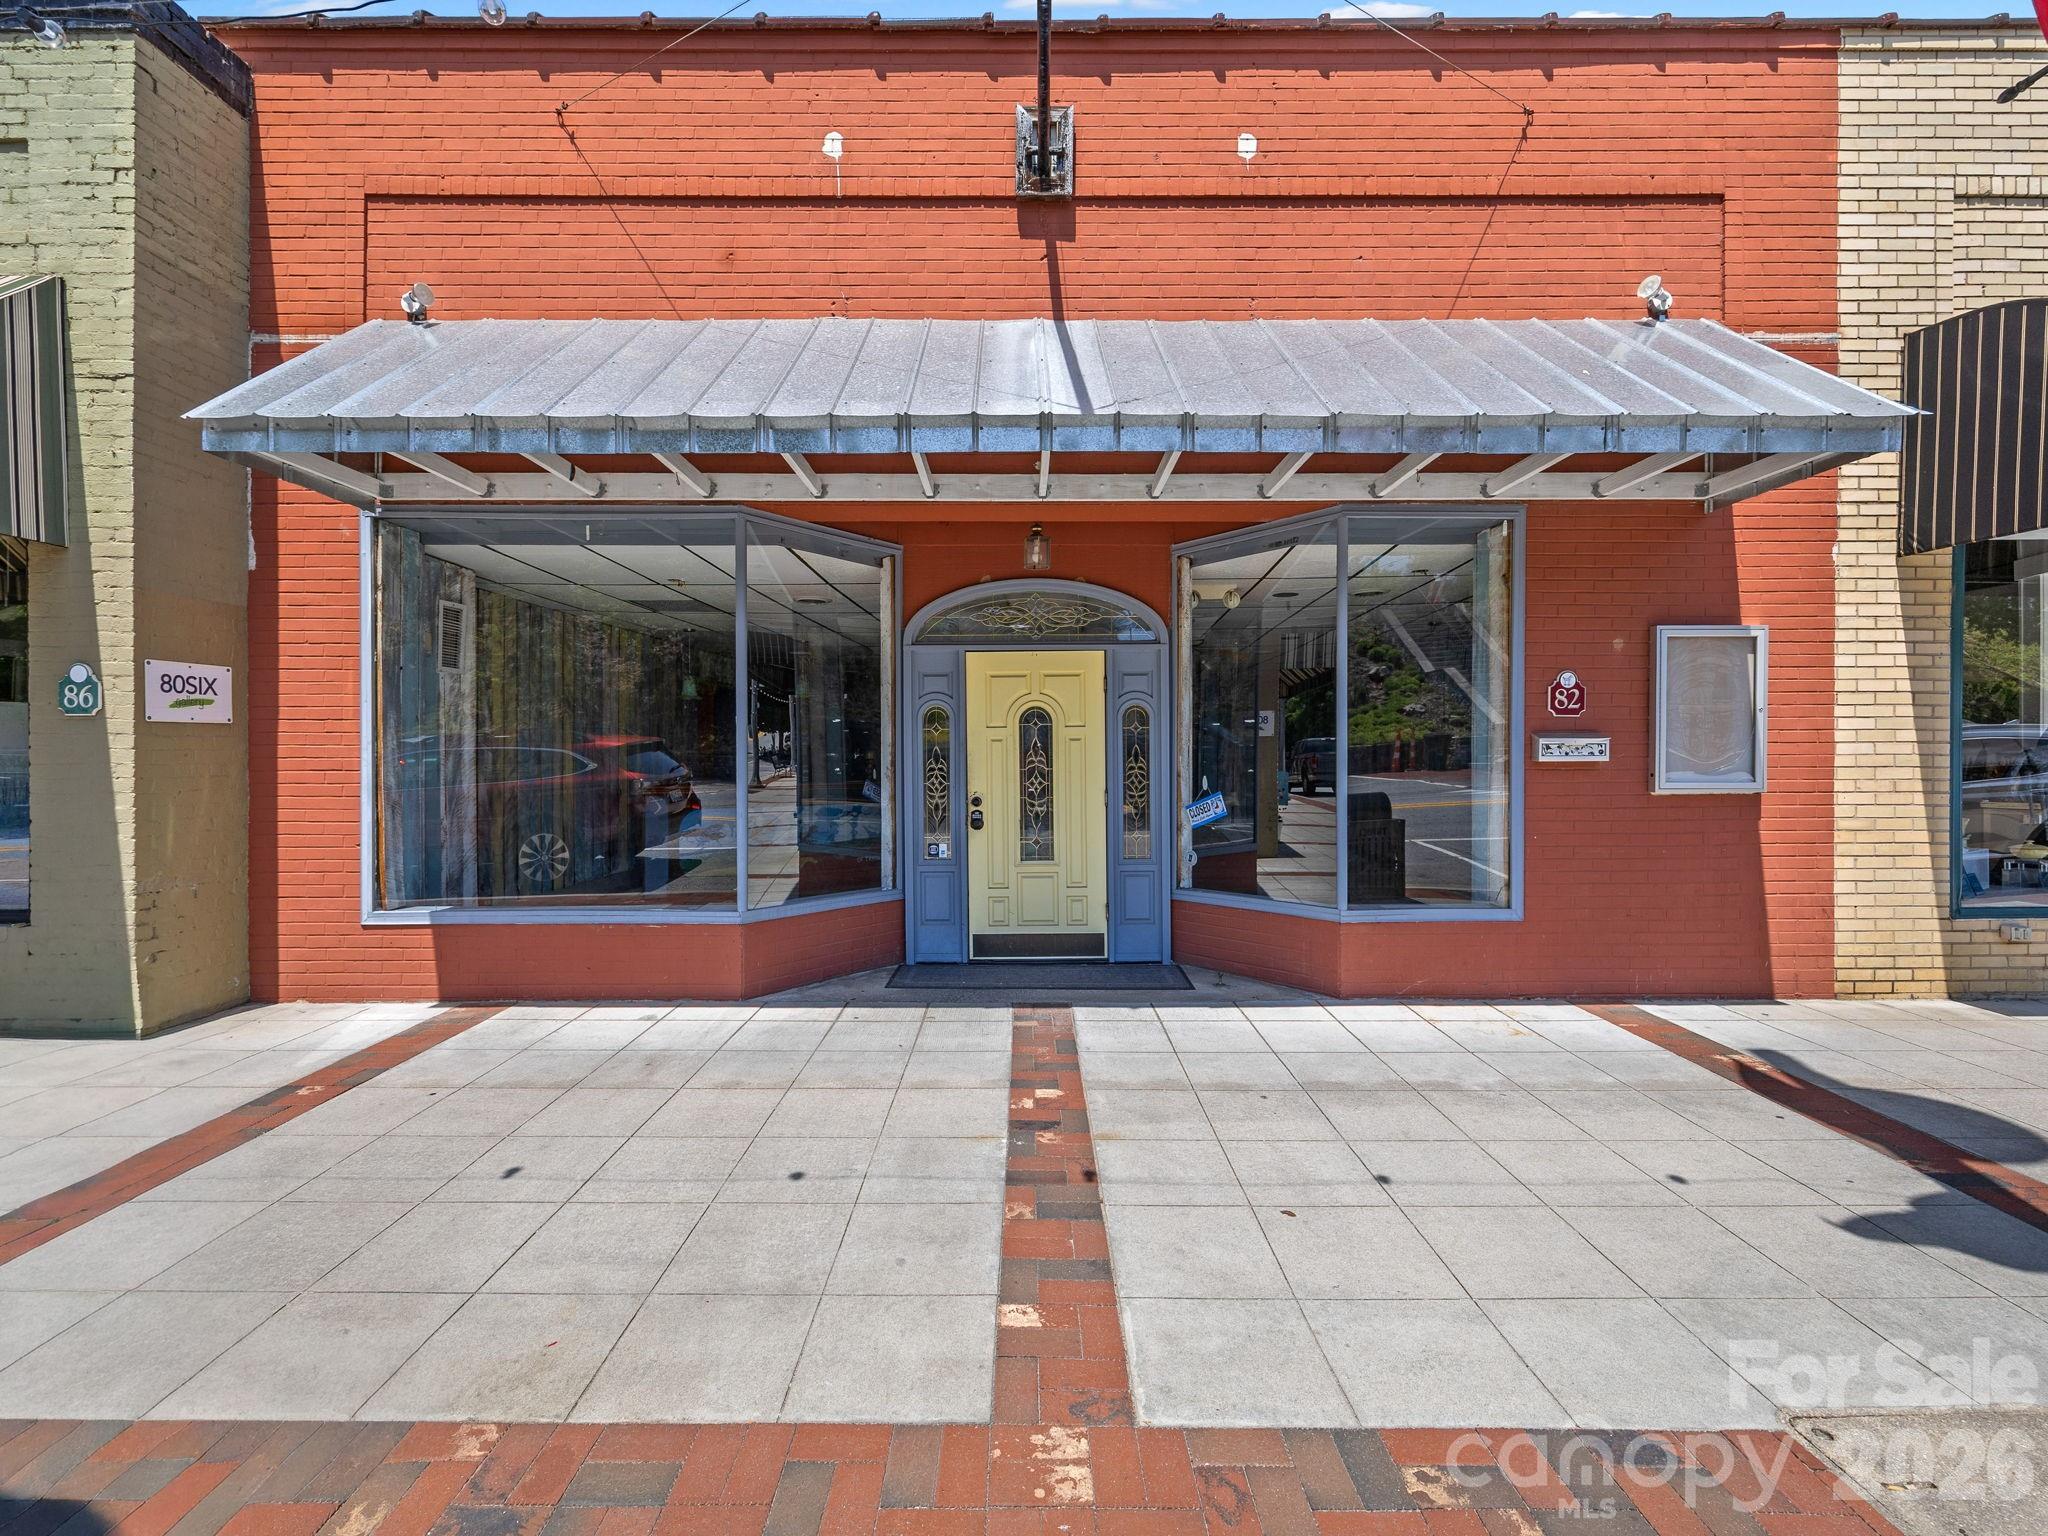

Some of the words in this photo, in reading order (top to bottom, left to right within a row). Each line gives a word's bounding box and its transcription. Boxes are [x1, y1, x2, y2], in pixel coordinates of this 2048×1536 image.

[160, 674, 218, 696] 80SIX
[64, 684, 93, 708] 86
[1555, 688, 1581, 709] 82
[1188, 802, 1211, 819] CLOSED
